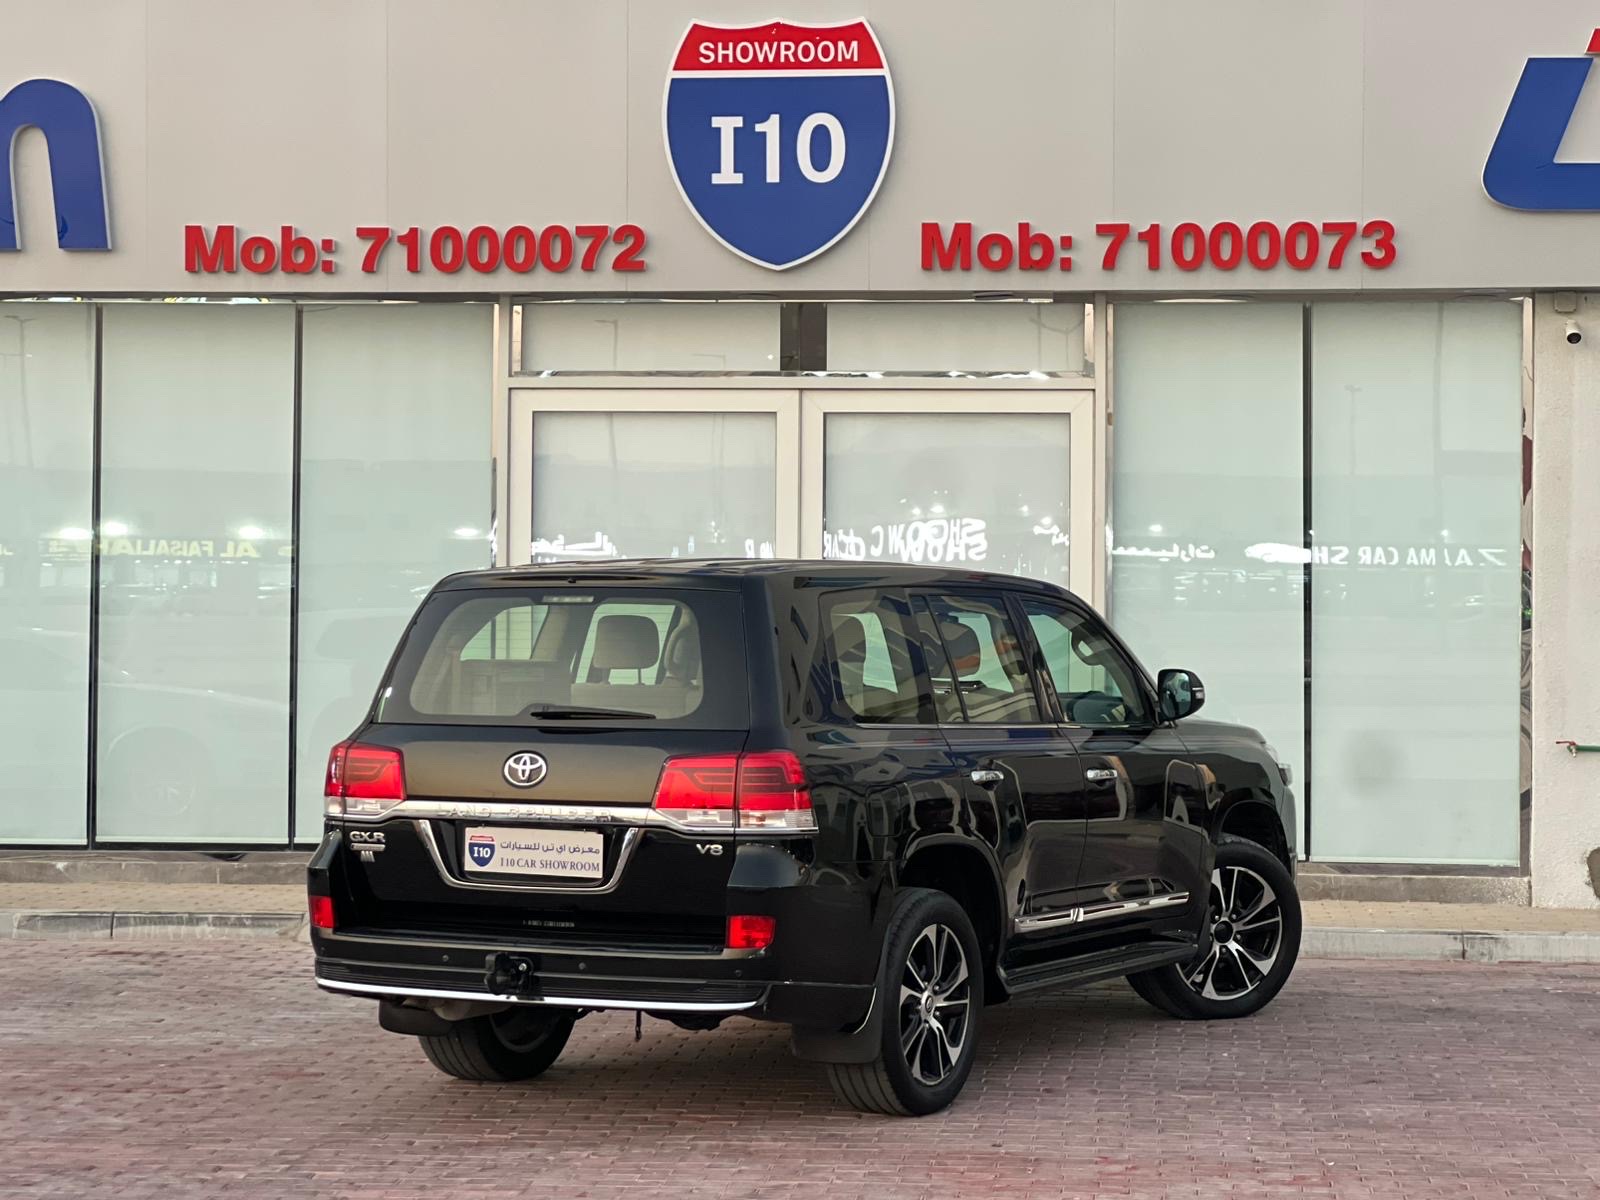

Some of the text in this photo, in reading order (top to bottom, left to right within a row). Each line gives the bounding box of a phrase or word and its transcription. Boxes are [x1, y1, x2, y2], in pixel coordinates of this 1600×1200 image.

[698, 40, 859, 64] SHOWROOM
[710, 111, 846, 184] I10
[184, 224, 647, 274] Mob: 71000072
[920, 219, 1397, 272] Mob: 71000073
[349, 830, 386, 843] GXR
[473, 846, 491, 858] I10
[695, 843, 724, 856] V8
[516, 858, 537, 868] CAR
[539, 858, 600, 872] SHOWROOM
